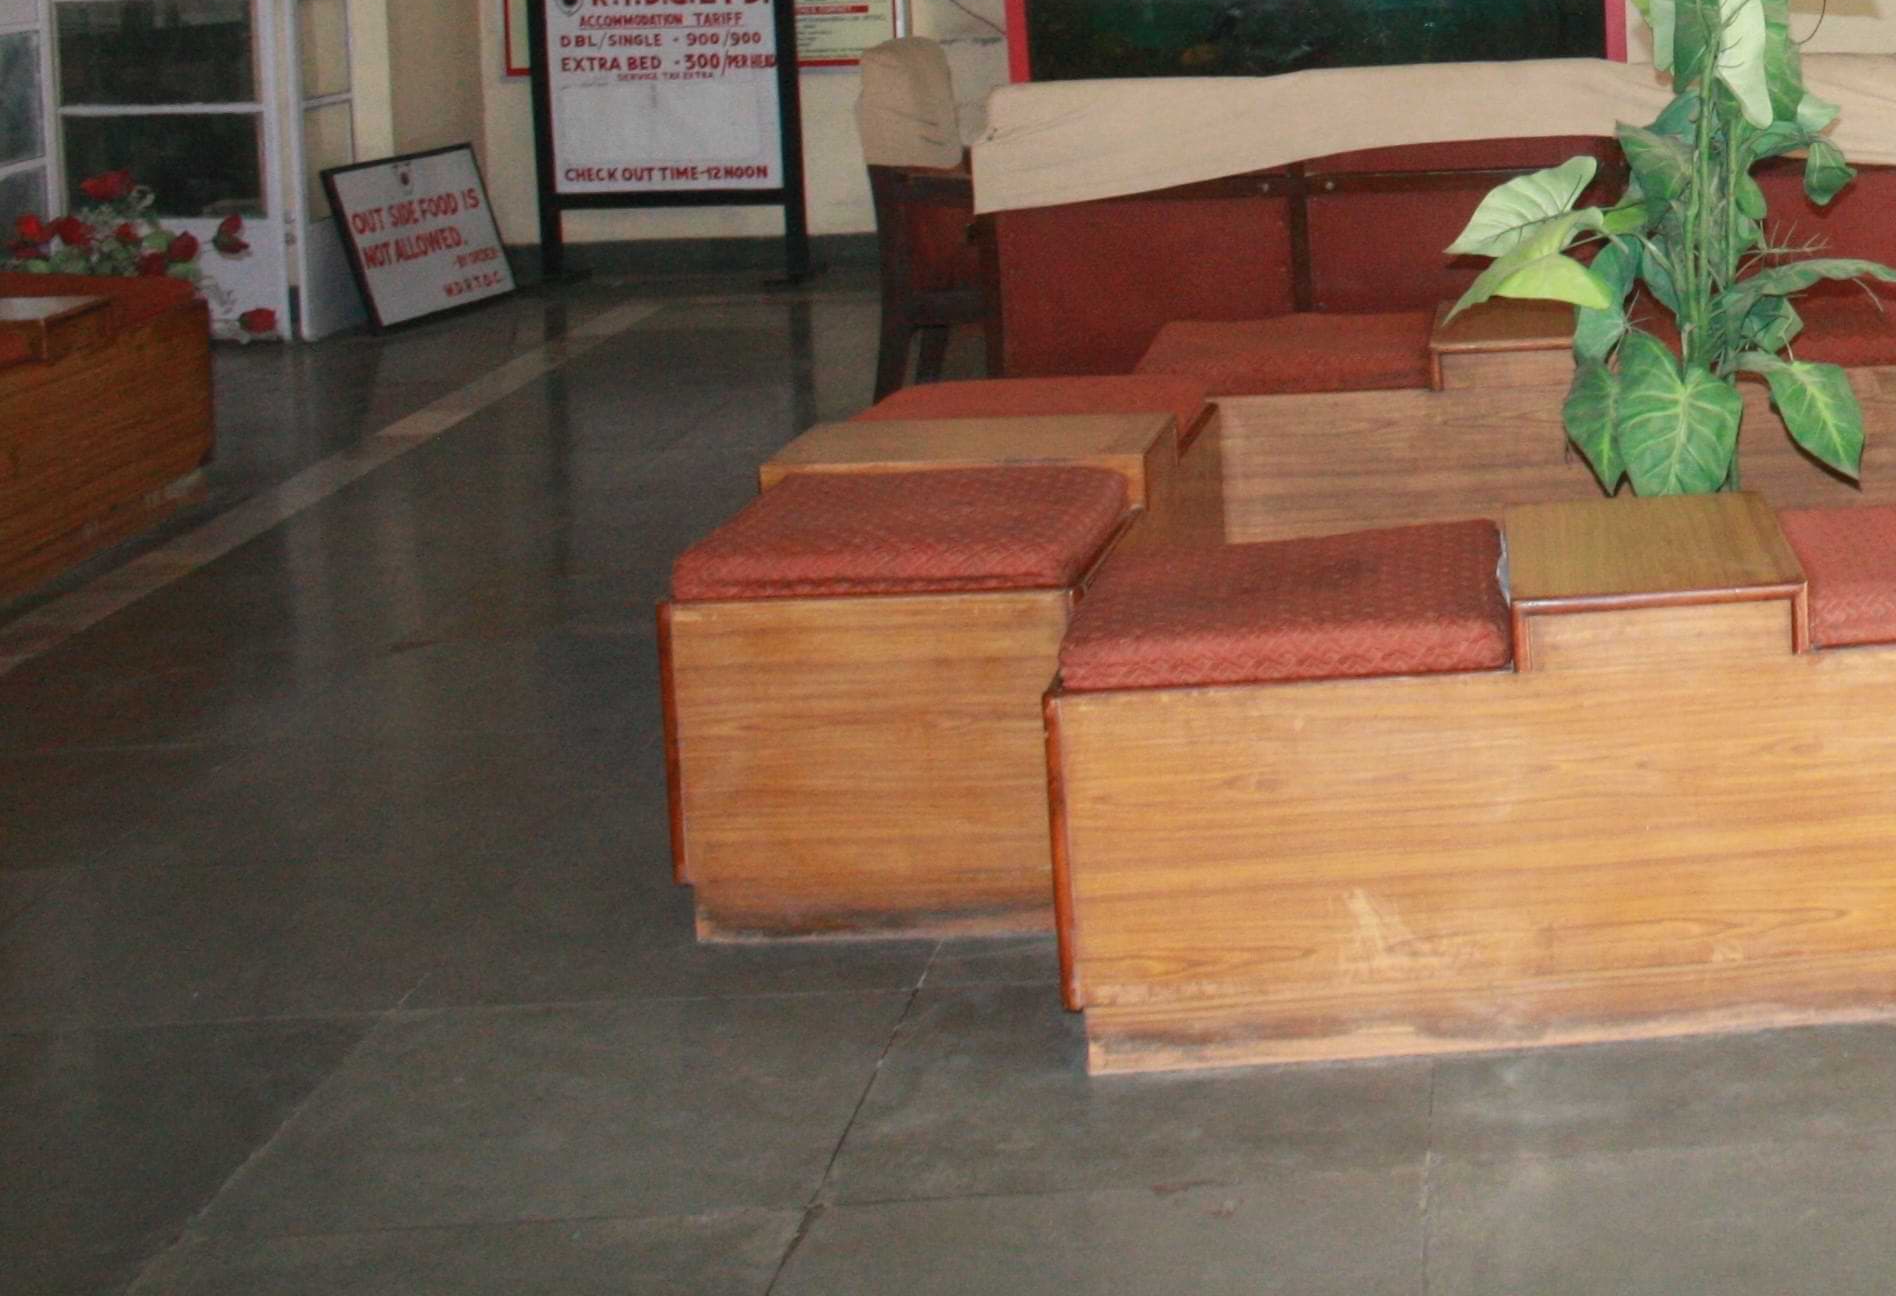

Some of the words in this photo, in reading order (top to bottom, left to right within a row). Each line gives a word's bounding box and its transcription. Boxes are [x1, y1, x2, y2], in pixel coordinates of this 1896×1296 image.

[579, 13, 683, 27] ACCOMMODATION
[694, 12, 743, 26] TARIFF
[561, 55, 621, 73] EXTRA
[627, 55, 661, 71] BED
[564, 167, 617, 183] CHECK
[621, 166, 654, 182] OUT
[724, 165, 768, 179] NOON
[352, 208, 385, 235] OUT
[388, 200, 420, 227] SIDE
[419, 192, 459, 220] FOOD
[462, 187, 480, 209] IS
[362, 242, 393, 270] NOT
